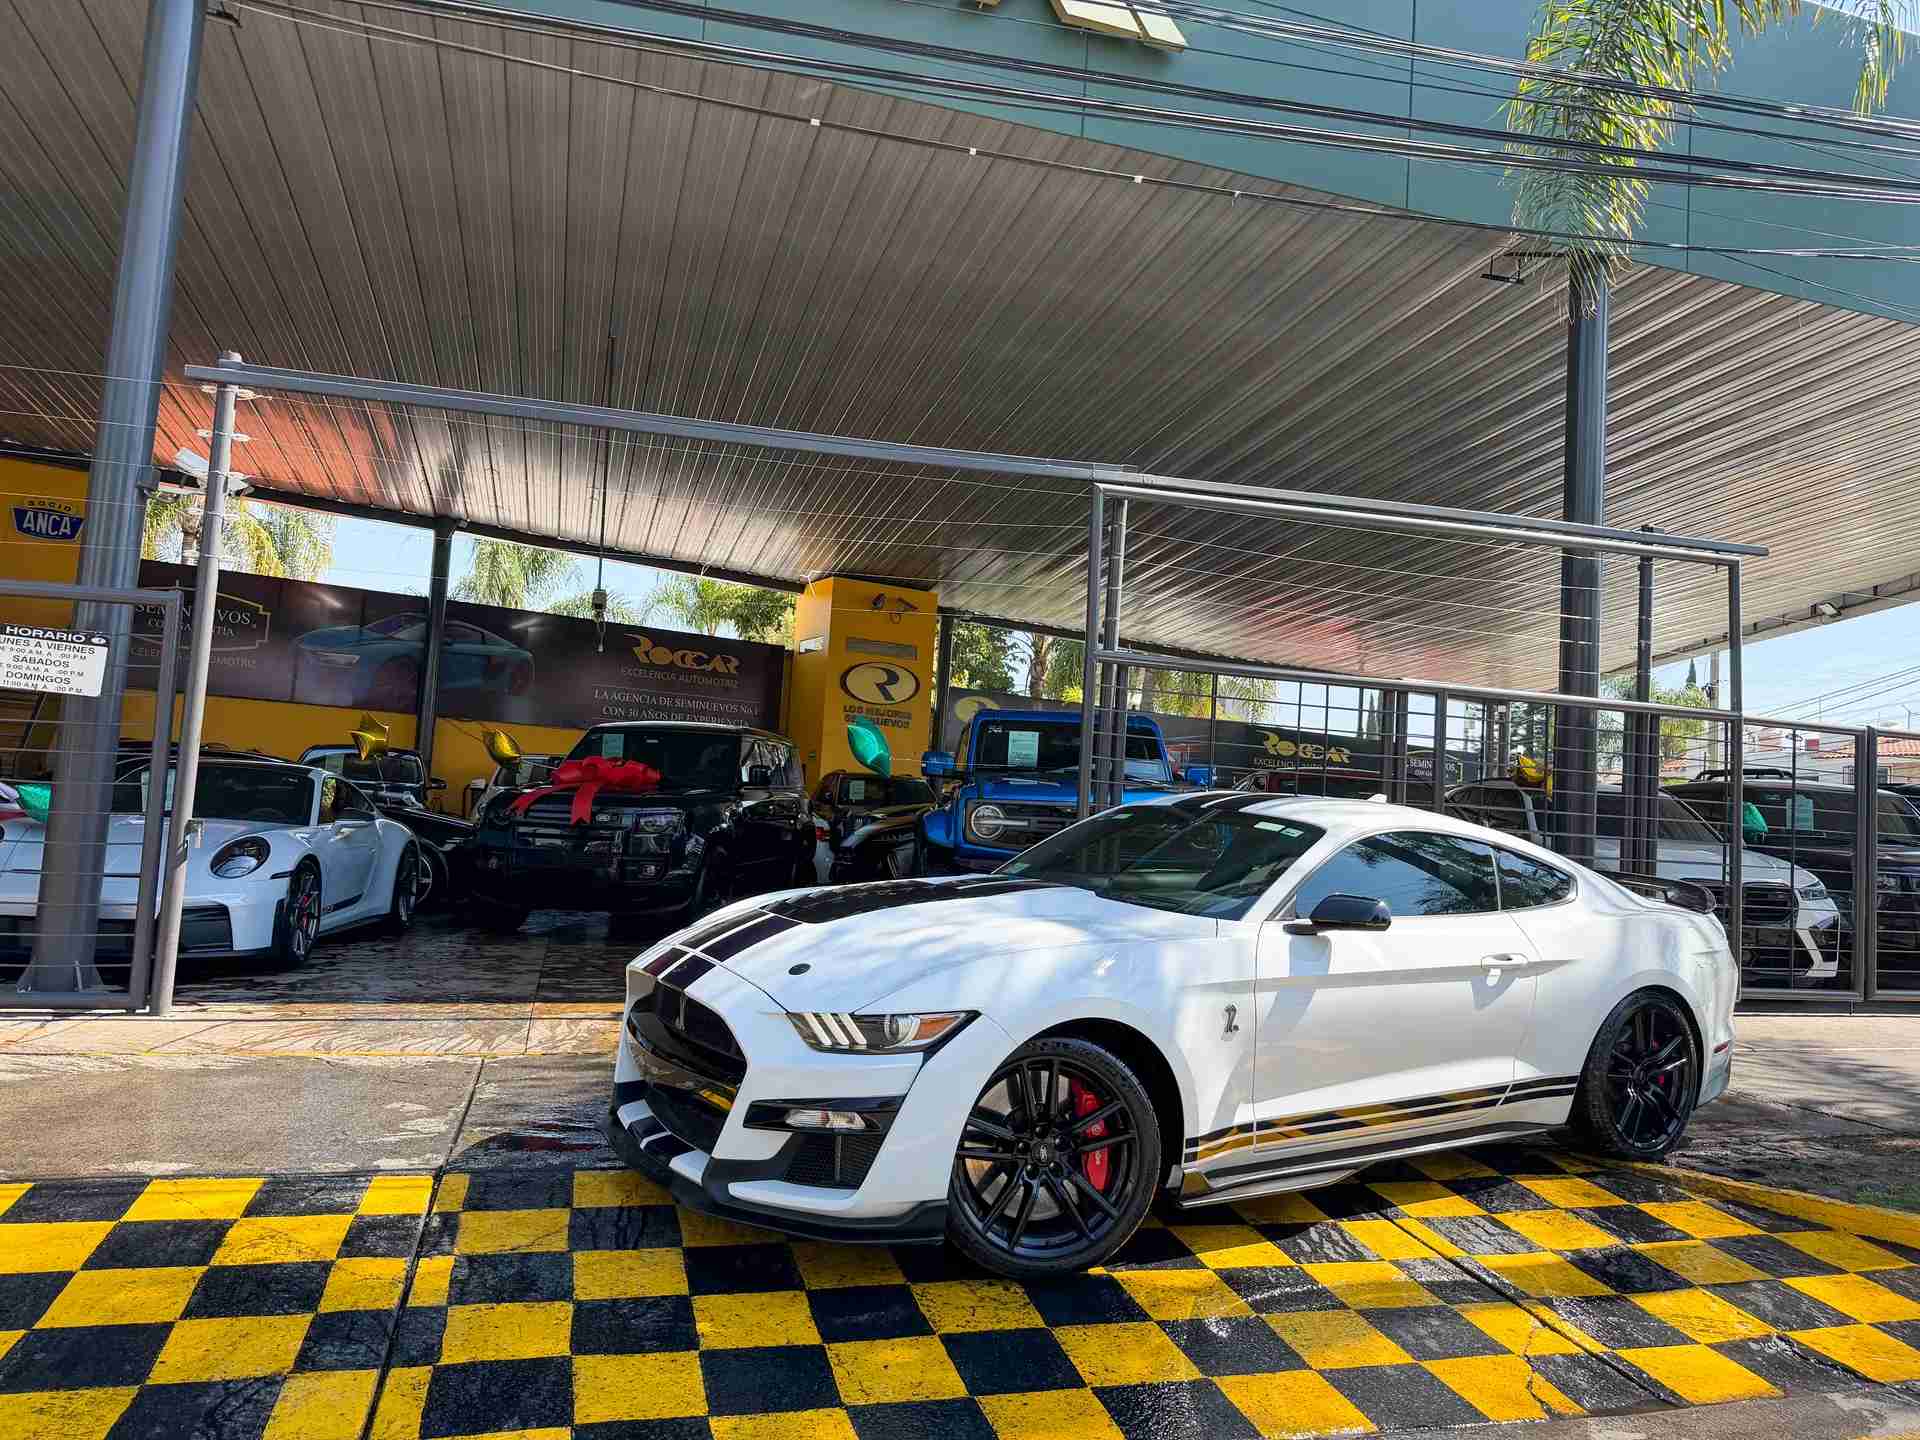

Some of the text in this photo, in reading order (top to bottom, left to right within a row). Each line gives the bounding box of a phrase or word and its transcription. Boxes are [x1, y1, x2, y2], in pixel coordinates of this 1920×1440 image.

[23, 511, 71, 535] ANCA
[5, 626, 86, 642] HORARIO
[0, 637, 95, 655] UNES A VIERNES
[12, 654, 70, 668] SABADOS
[6, 671, 71, 685] DOMINGOS
[594, 688, 608, 699] LA
[610, 689, 657, 705] AGENCIA
[602, 706, 625, 717] CON
[670, 711, 685, 720] DE
